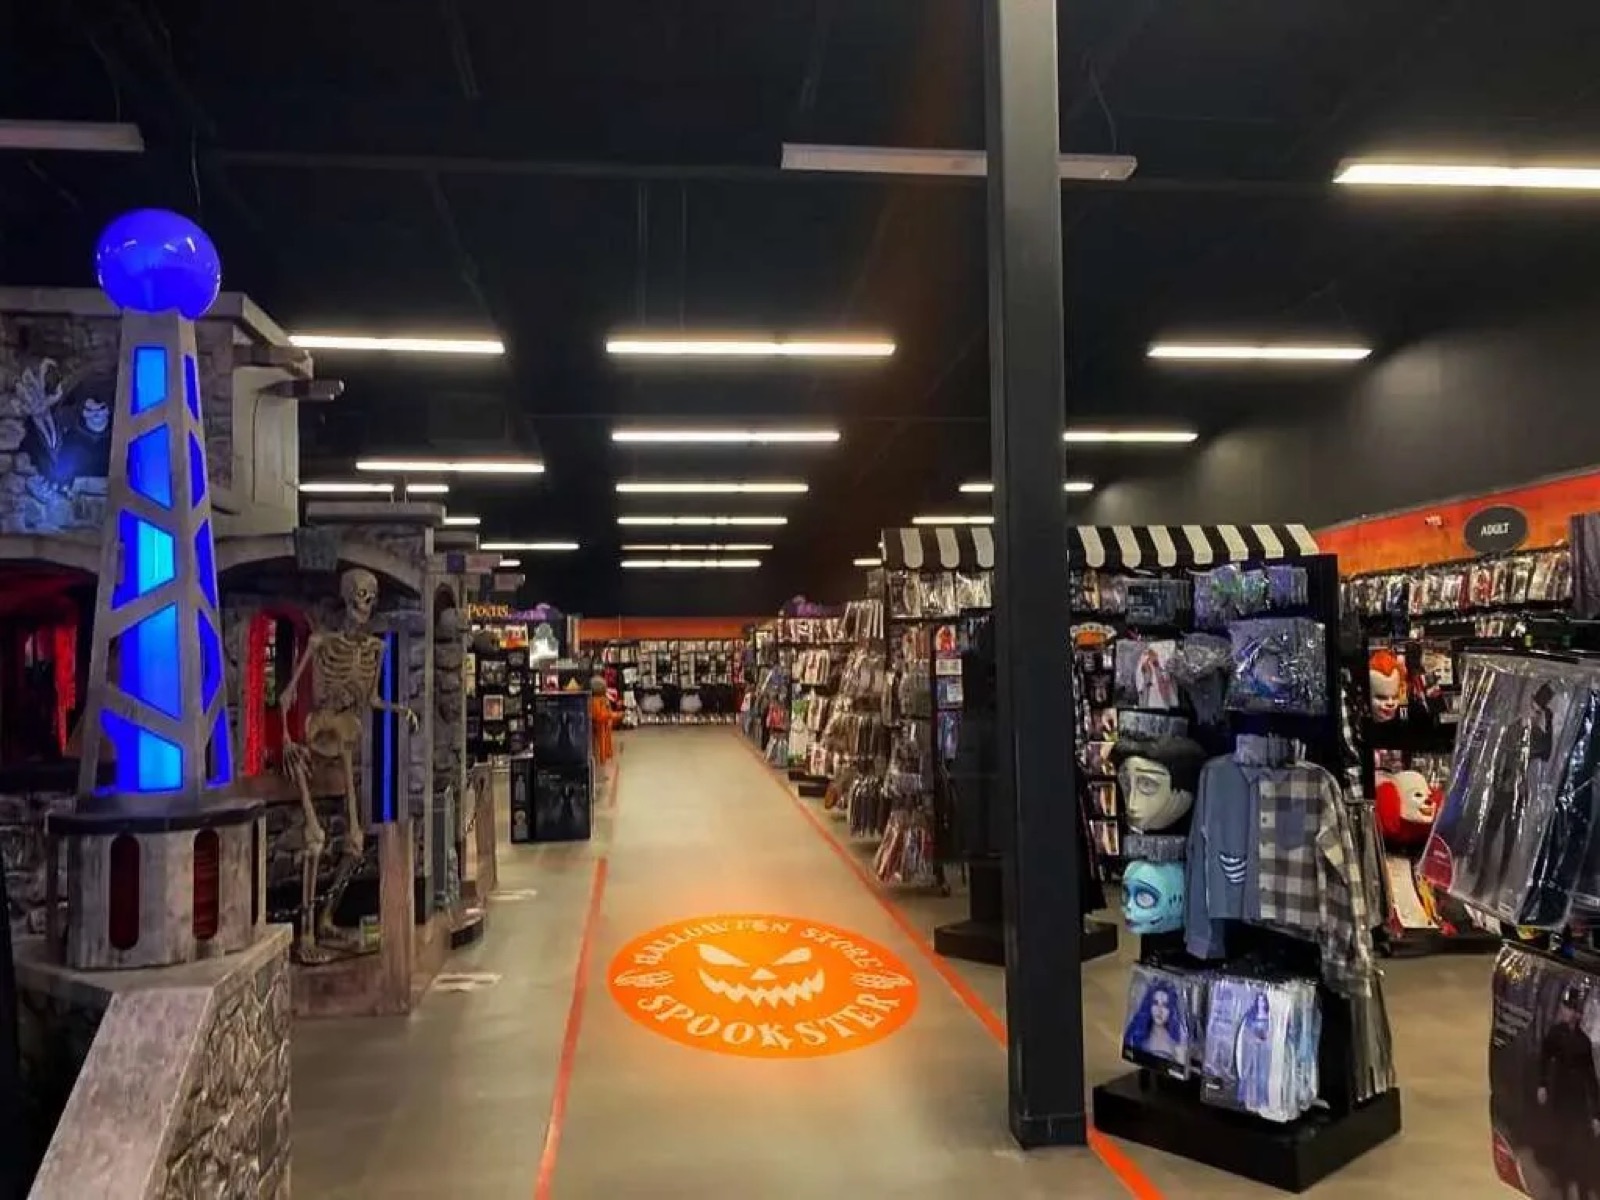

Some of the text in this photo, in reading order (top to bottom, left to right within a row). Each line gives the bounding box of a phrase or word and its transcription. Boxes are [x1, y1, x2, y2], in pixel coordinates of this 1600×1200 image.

[1480, 522, 1510, 537] ADULT
[799, 927, 884, 969] STORE
[637, 993, 901, 1050] SPOOKSTER
